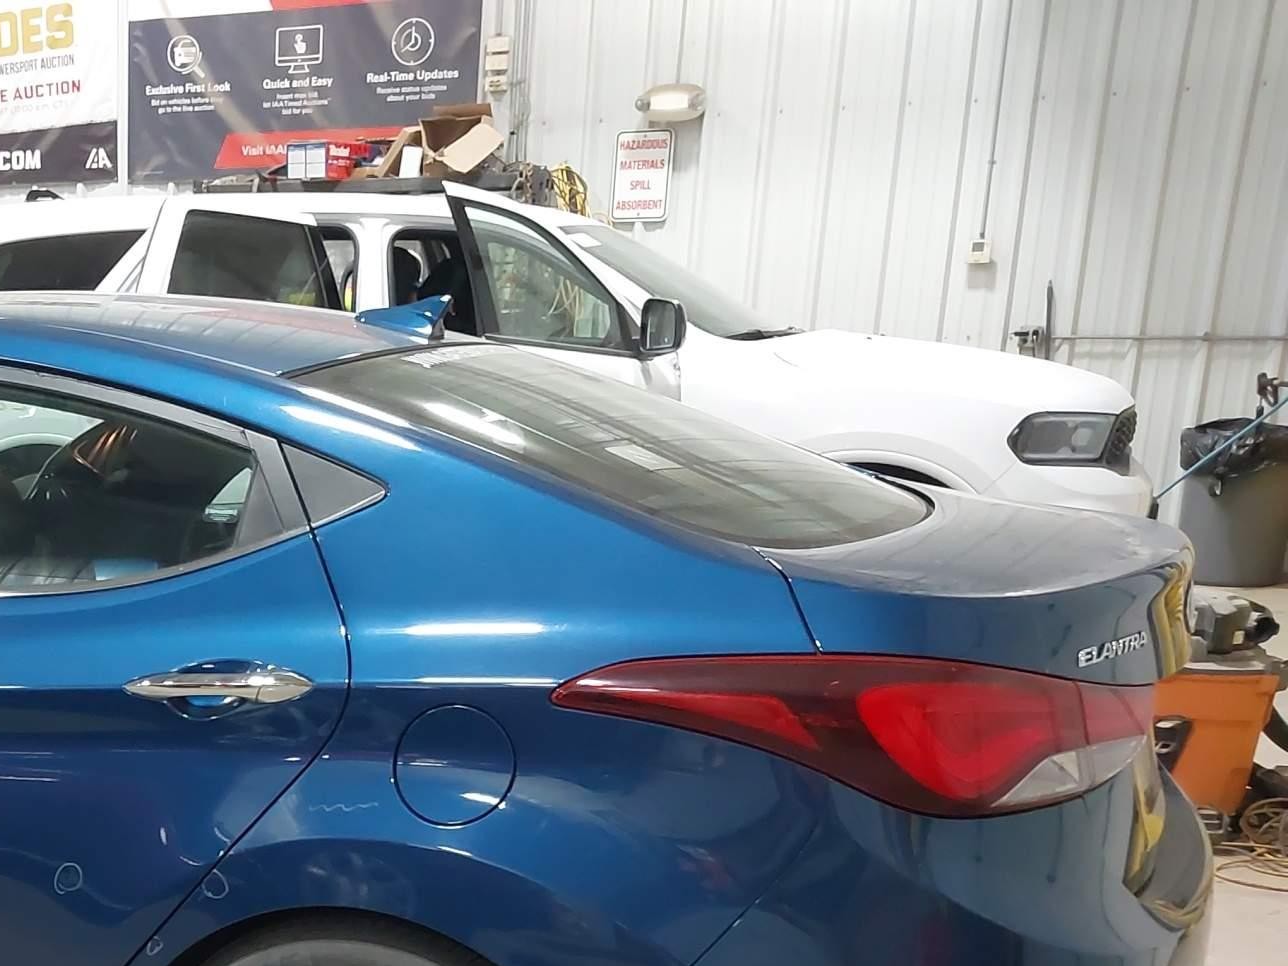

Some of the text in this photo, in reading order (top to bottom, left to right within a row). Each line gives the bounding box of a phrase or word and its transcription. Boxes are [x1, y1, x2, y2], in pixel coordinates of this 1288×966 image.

[40, 54, 75, 72] AUCTION
[263, 76, 334, 90] Quick and Easy
[366, 69, 459, 83] Real-Time Updates
[13, 79, 81, 101] AUCTION
[145, 81, 231, 96] Exclusive First Look
[241, 145, 263, 156] Visit
[620, 138, 668, 151] HAZARDOUS
[620, 159, 665, 170] MATERIALS
[630, 180, 651, 190] SPILL
[616, 199, 663, 210] ABSORBENT
[1077, 631, 1148, 668] ELANTRA
